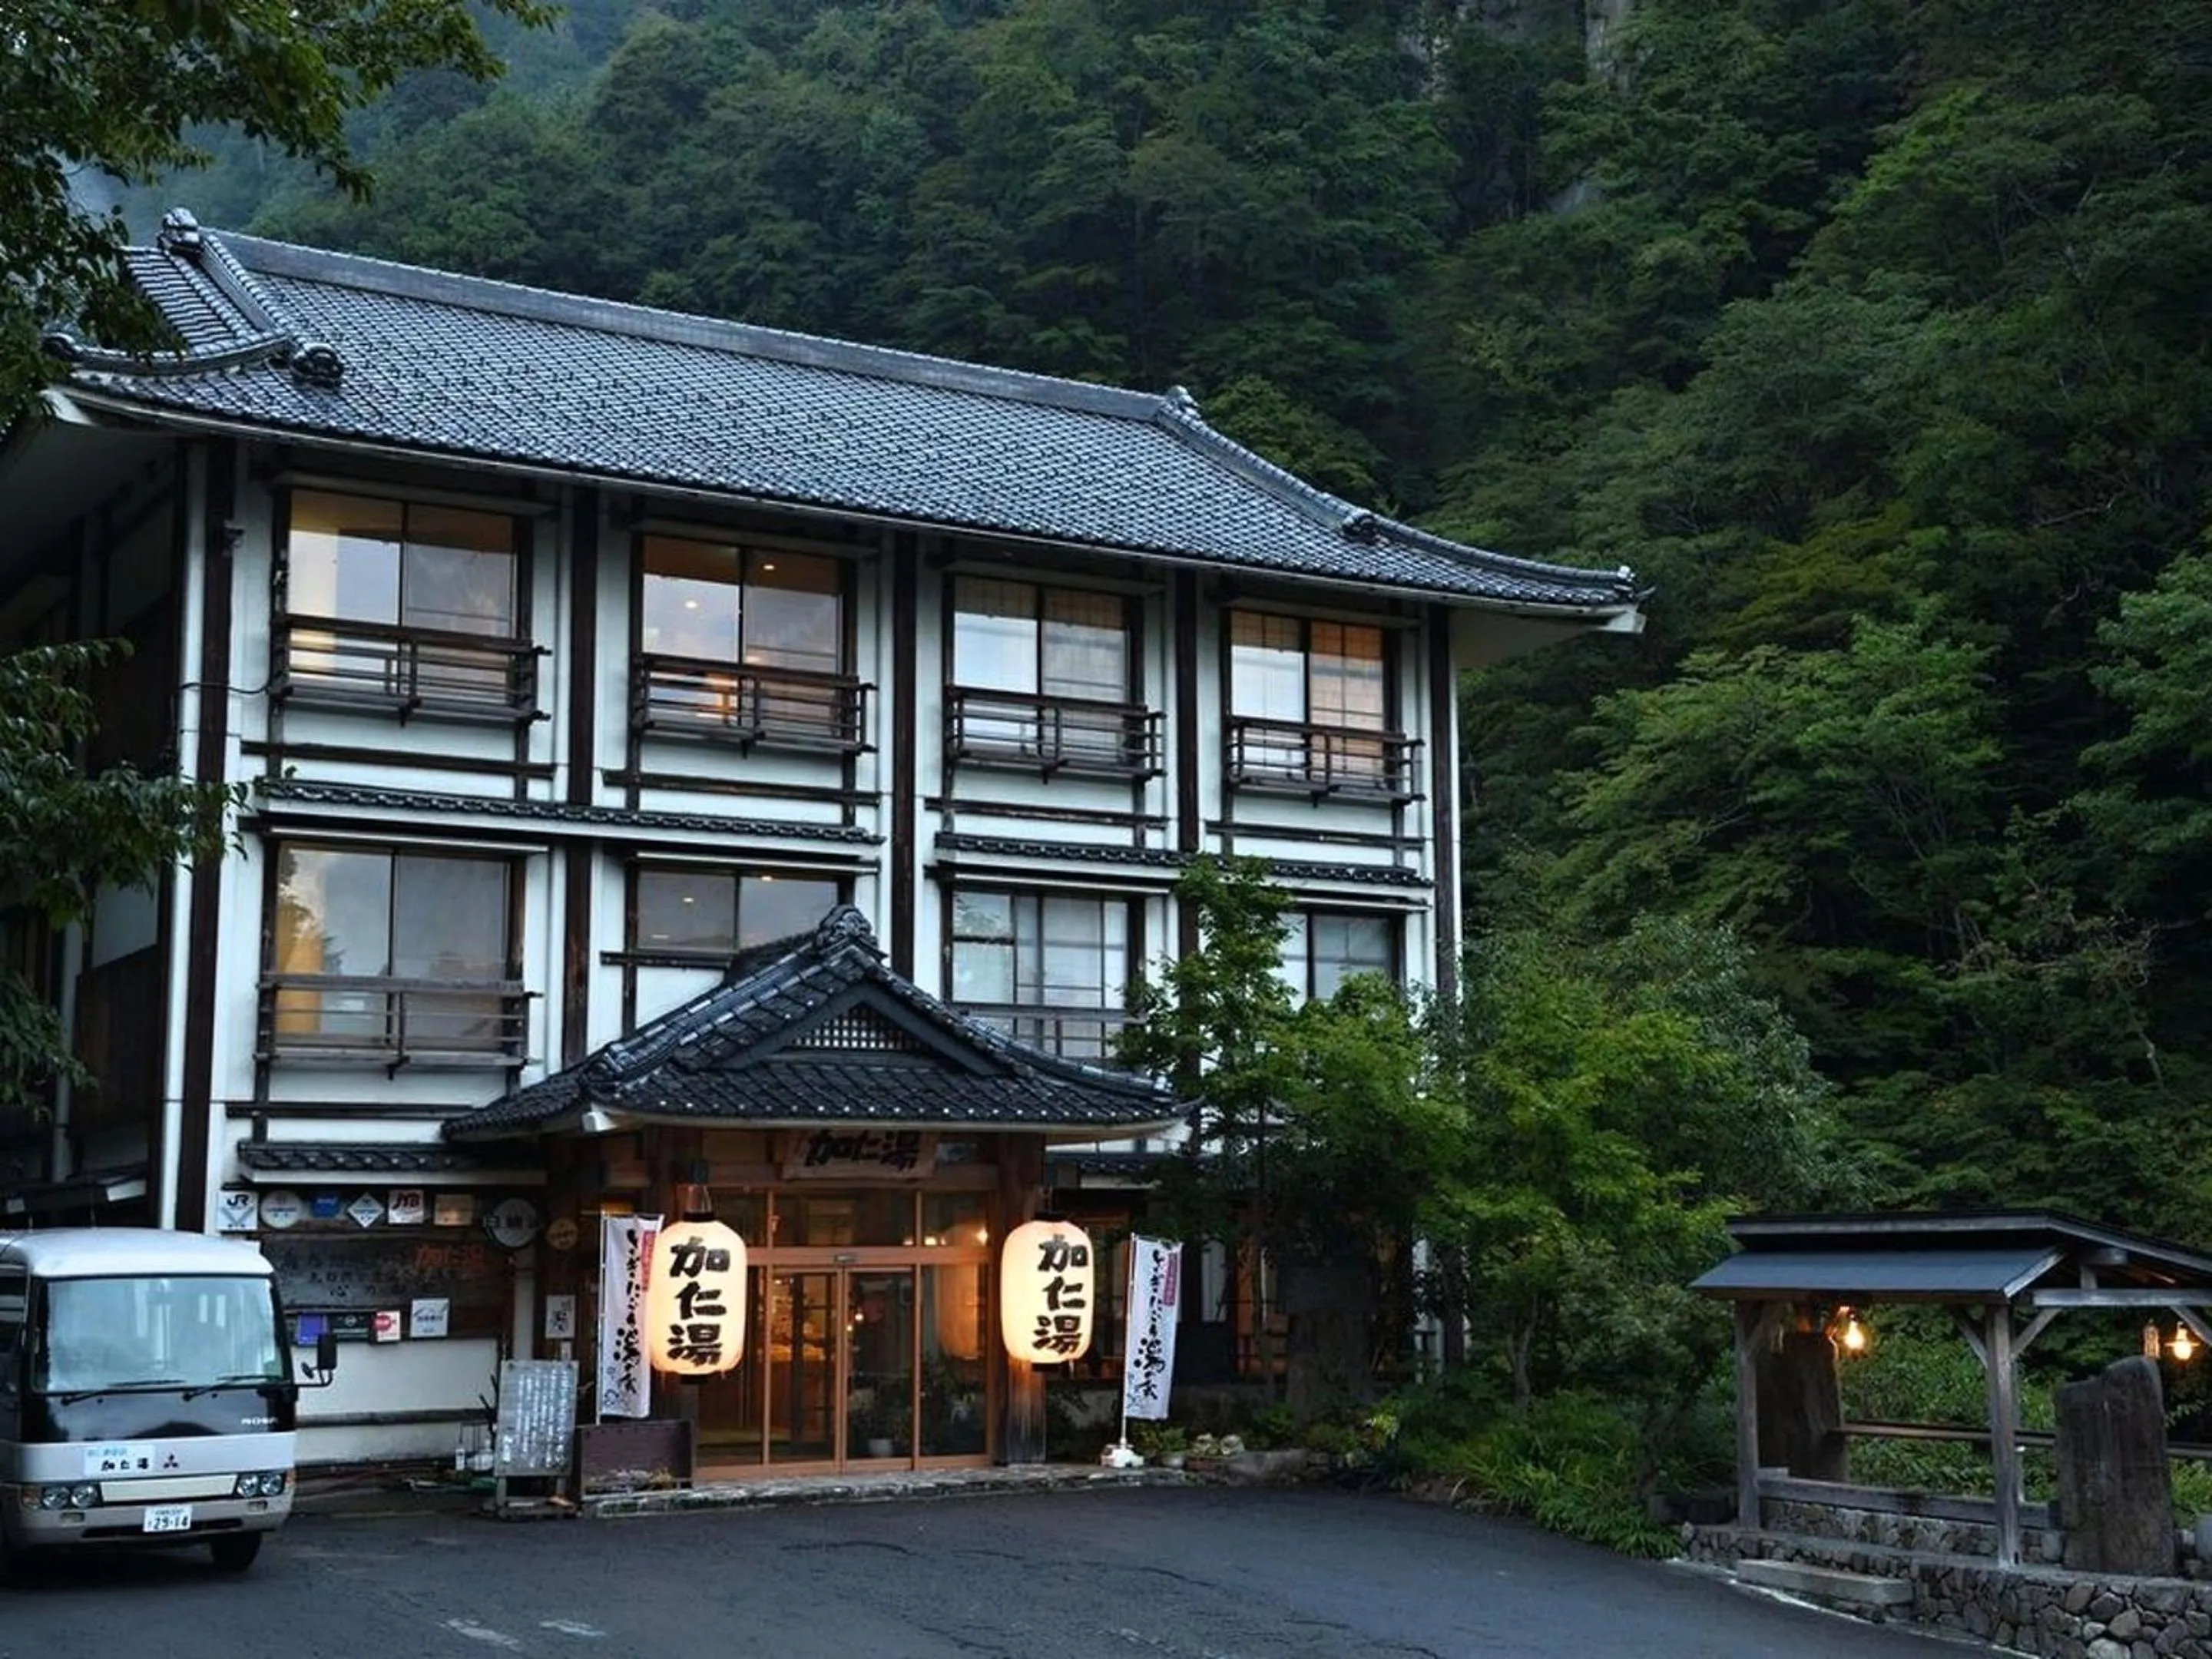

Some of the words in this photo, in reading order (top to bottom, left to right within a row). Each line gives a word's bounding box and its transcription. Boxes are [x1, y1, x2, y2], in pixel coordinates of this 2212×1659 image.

[805, 1129, 920, 1171] 加仁湯
[227, 1194, 250, 1207] JR
[392, 1192, 420, 1210] JTB
[667, 1236, 730, 1366] 加仁湯
[1032, 1233, 1089, 1356] 加仁湯
